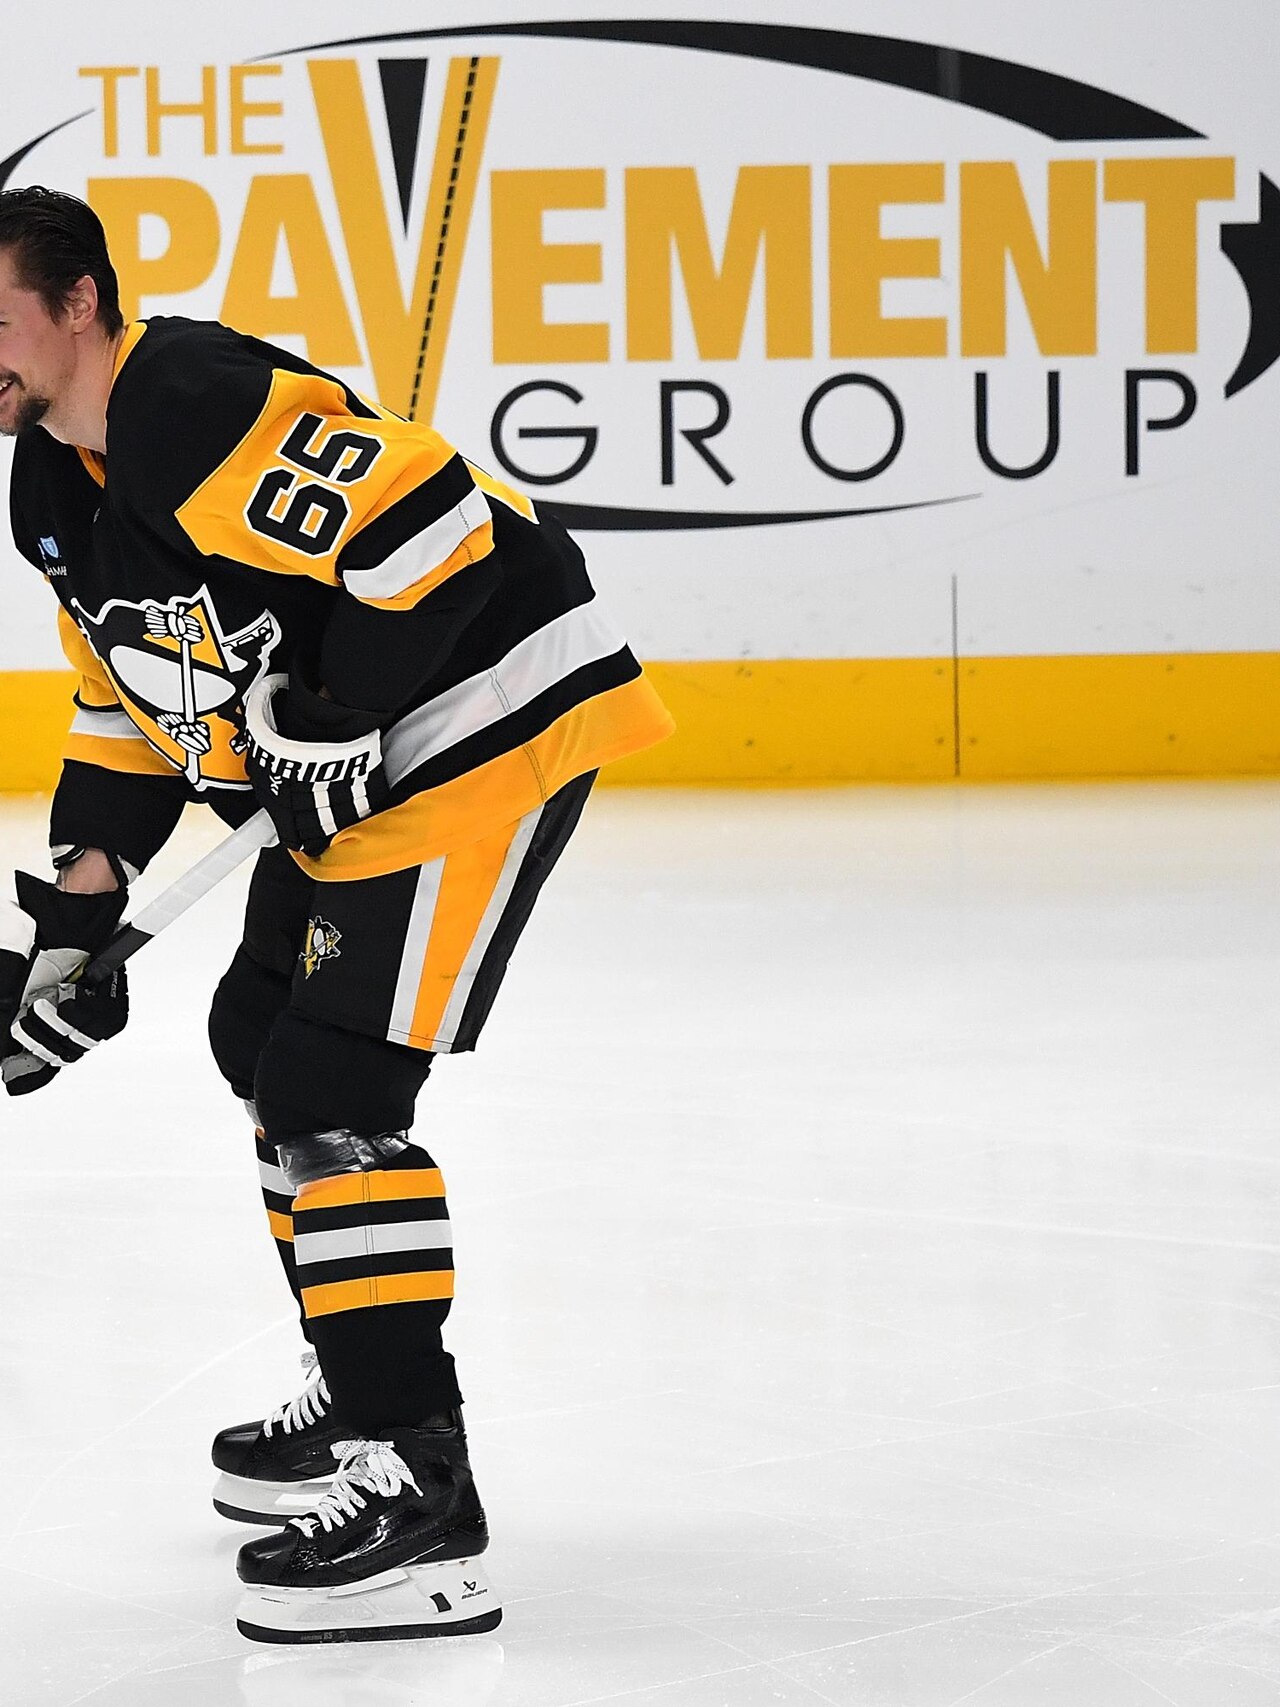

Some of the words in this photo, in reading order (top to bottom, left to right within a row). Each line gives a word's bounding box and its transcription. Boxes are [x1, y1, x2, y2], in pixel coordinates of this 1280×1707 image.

[78, 64, 284, 158] THE
[87, 56, 1236, 424] PAVEMENT
[242, 411, 387, 560] 65
[490, 370, 1198, 486] GROUP
